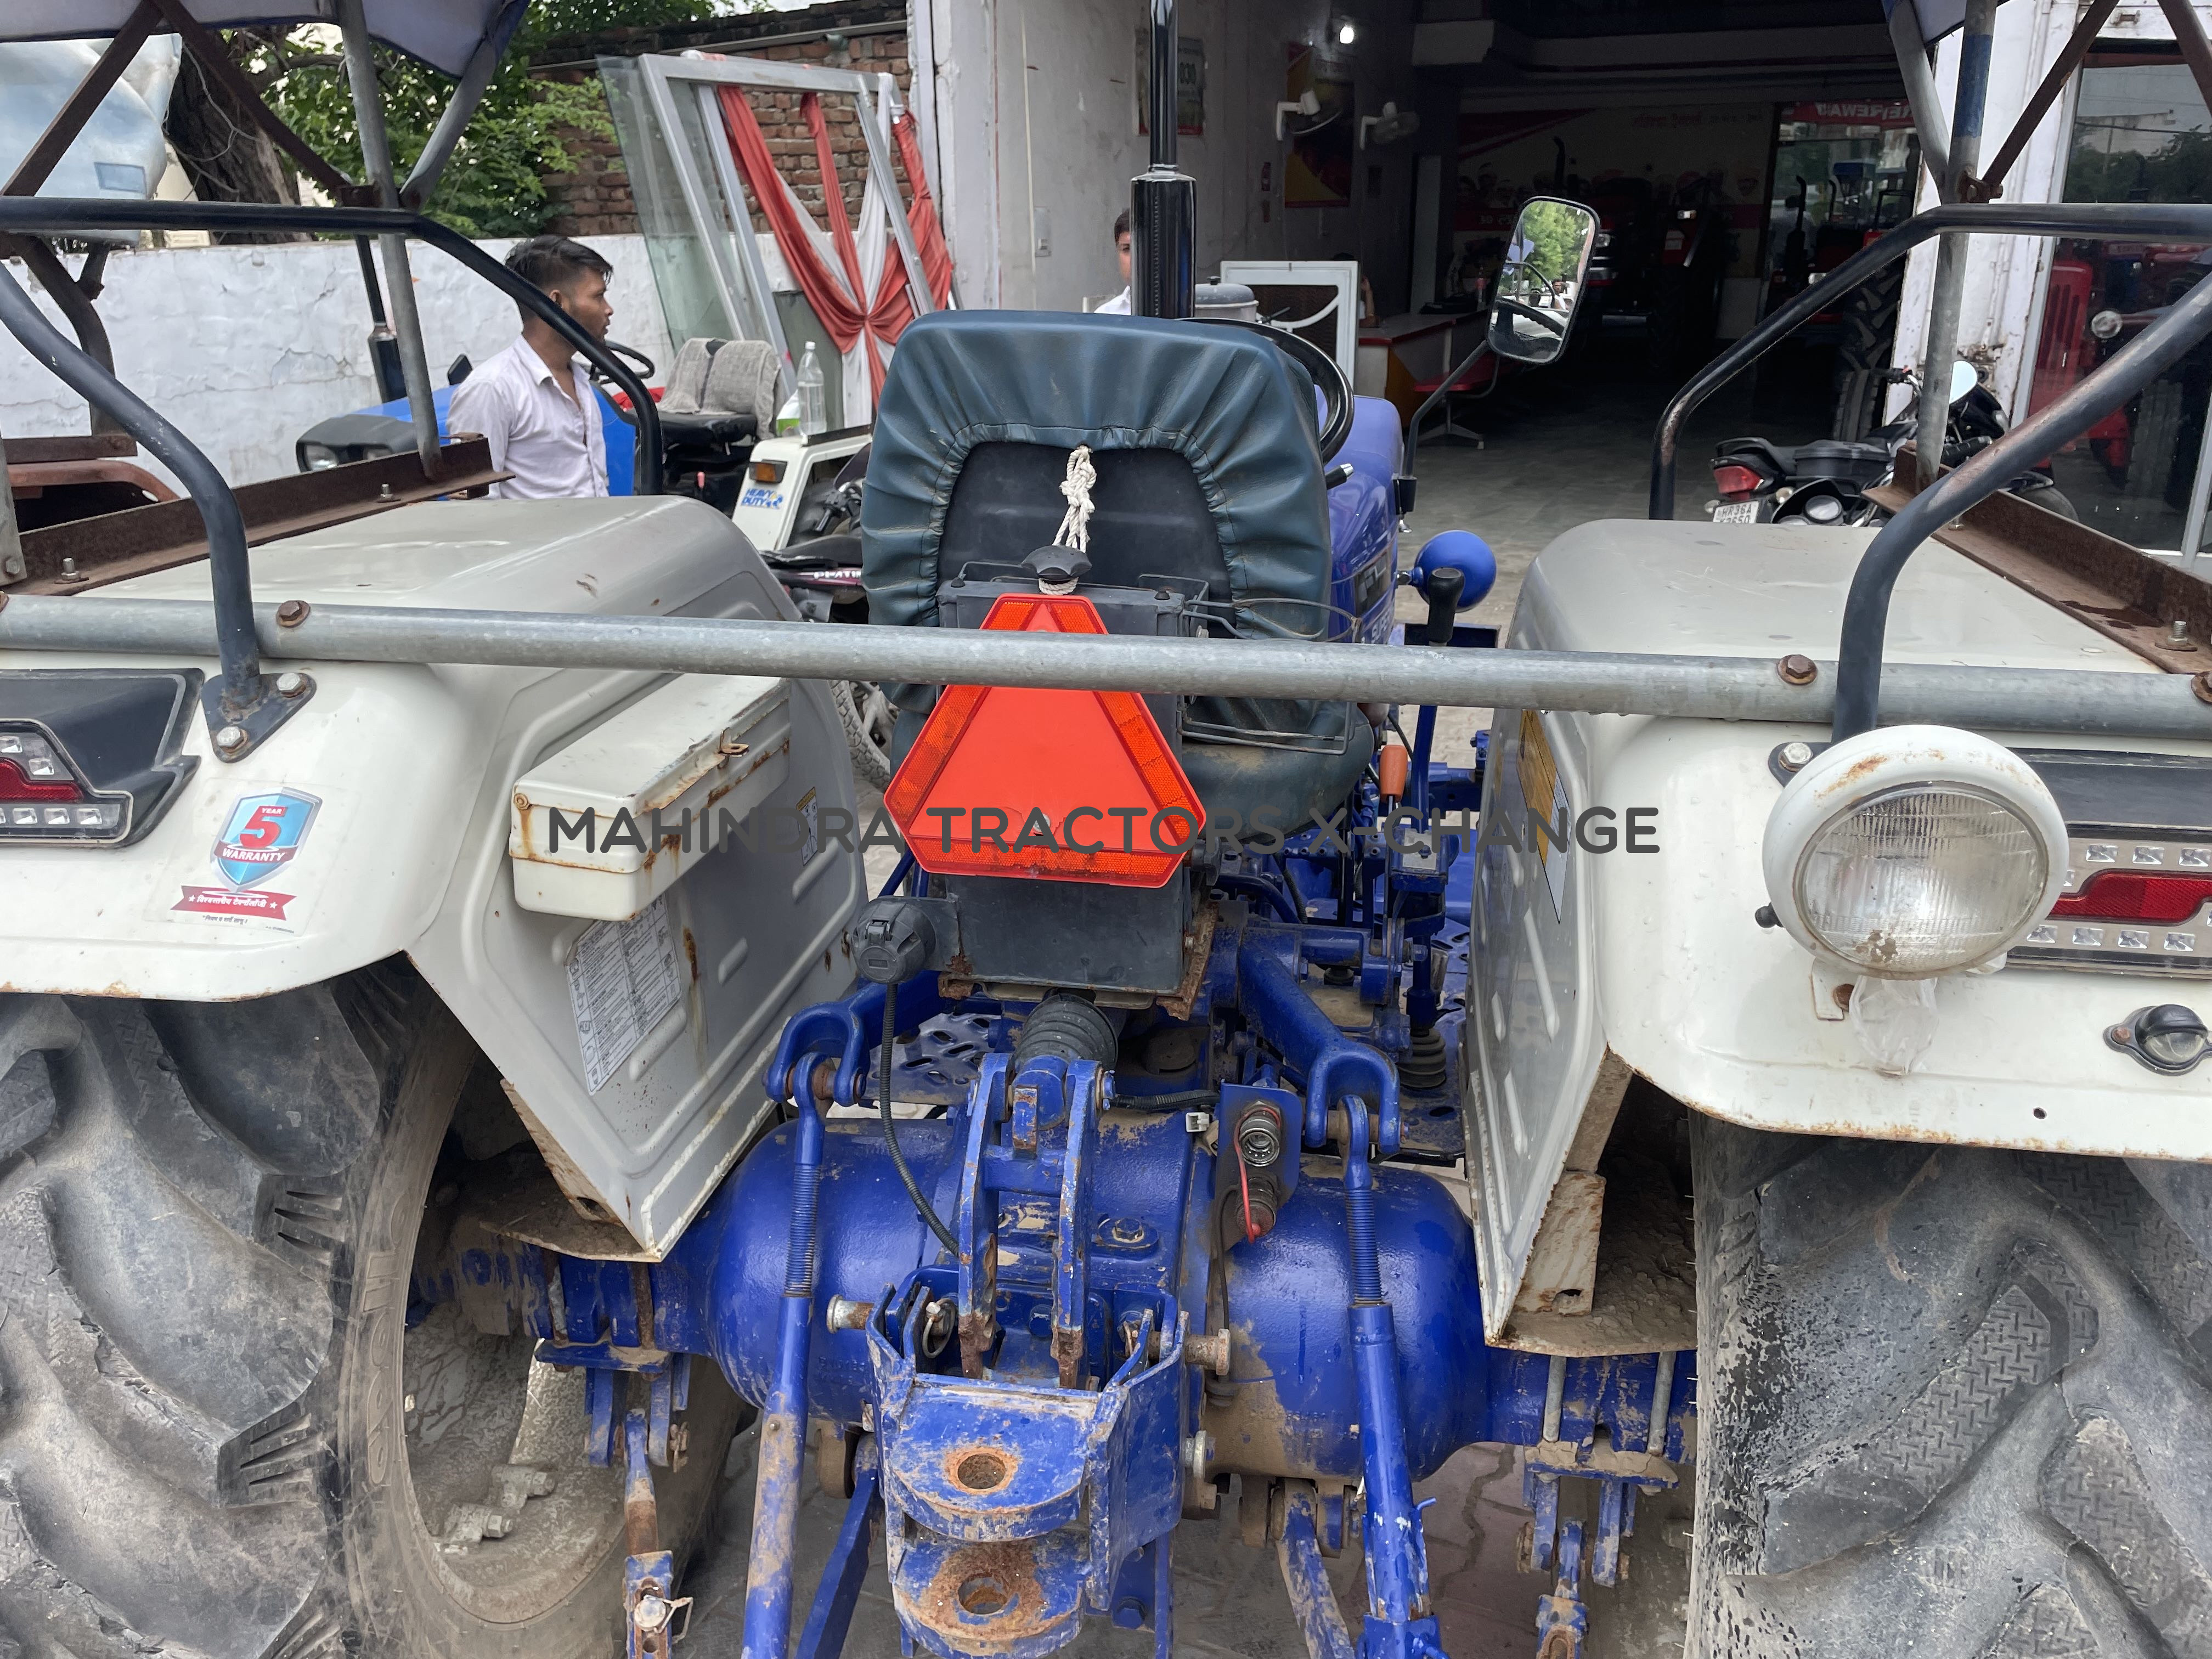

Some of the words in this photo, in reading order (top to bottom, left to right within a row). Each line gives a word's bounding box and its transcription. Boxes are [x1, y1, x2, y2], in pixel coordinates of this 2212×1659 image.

[747, 489, 774, 497] HEAVY
[741, 497, 766, 506] DUTY
[1723, 504, 1751, 516] HR36A
[240, 806, 287, 849] 5
[222, 848, 285, 861] WARRANTY
[363, 1192, 411, 1485] apollo
